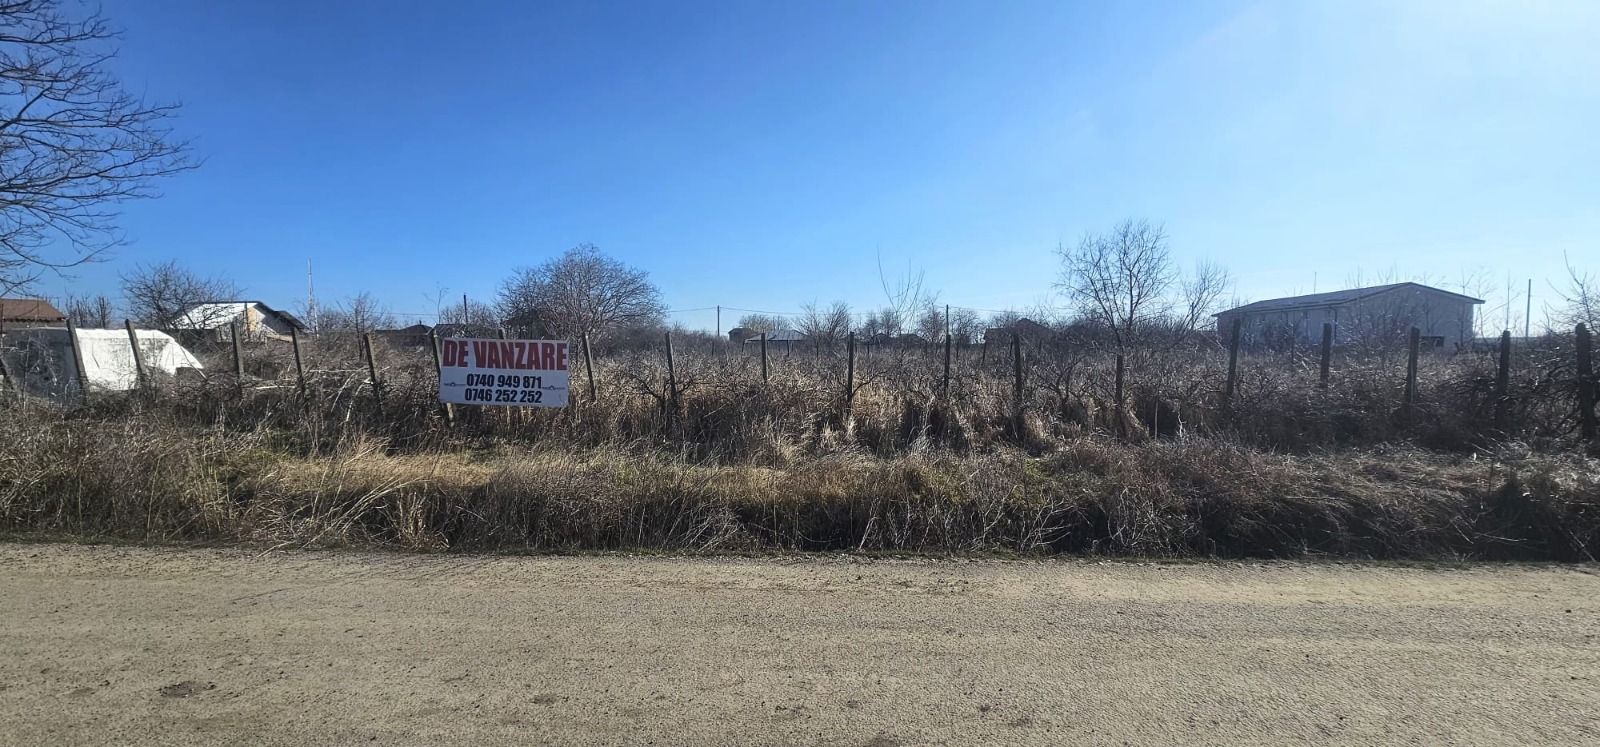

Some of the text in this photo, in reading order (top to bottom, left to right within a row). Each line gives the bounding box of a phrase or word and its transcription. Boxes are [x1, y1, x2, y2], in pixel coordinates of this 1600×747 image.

[443, 340, 567, 370] DE VANZARE
[467, 373, 495, 387] 0740
[497, 375, 520, 388] 949
[523, 376, 542, 389] 871
[465, 388, 542, 403] 0746 252 252
